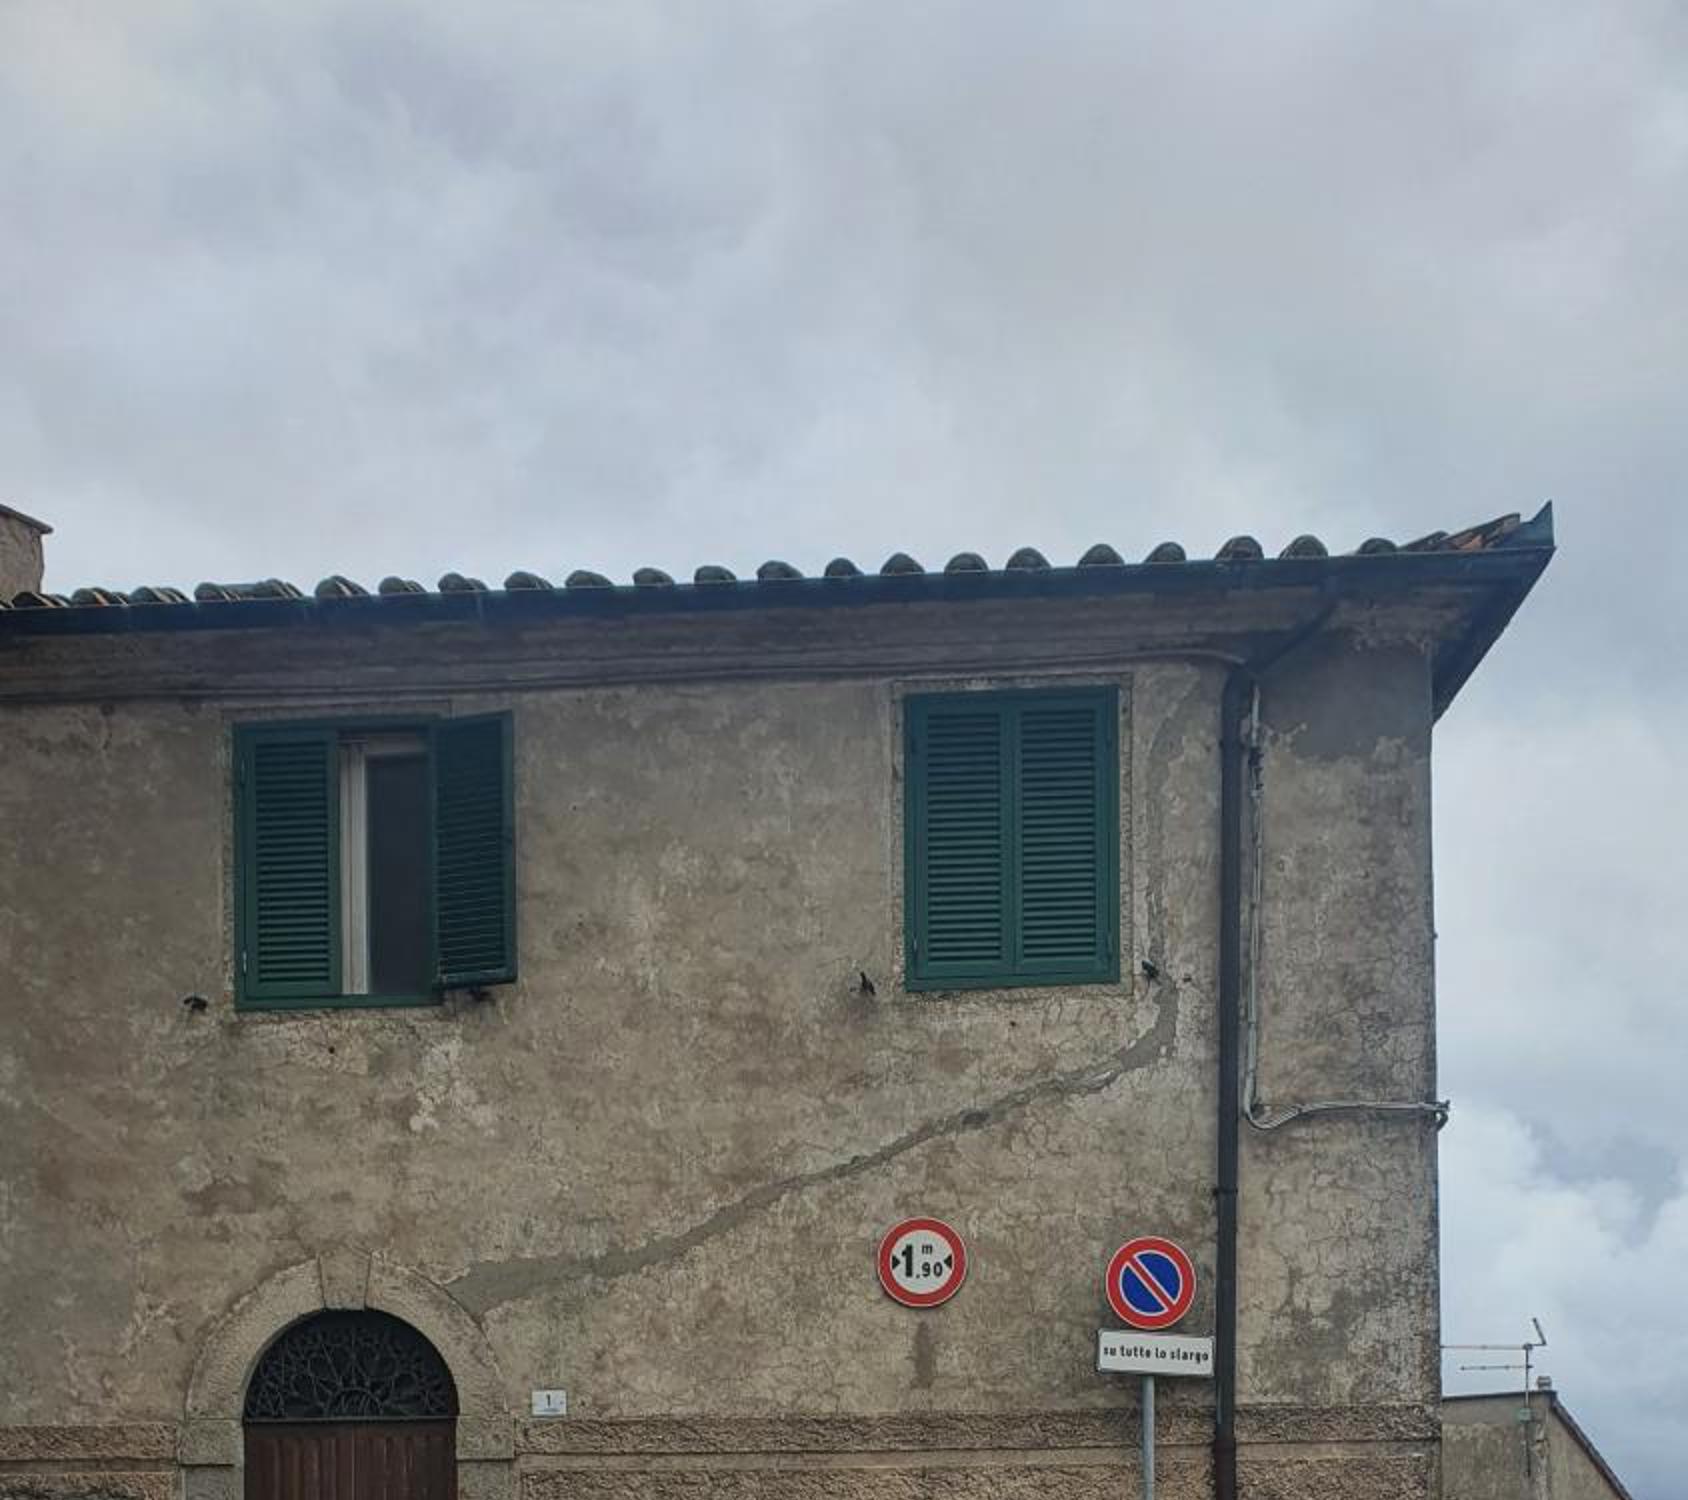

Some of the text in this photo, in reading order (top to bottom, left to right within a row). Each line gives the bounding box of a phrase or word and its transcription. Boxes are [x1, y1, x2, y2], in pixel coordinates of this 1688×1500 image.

[921, 1244, 934, 1255] m
[1104, 1345, 1209, 1364] su tutto lo slargo
[545, 1393, 552, 1407] 1
